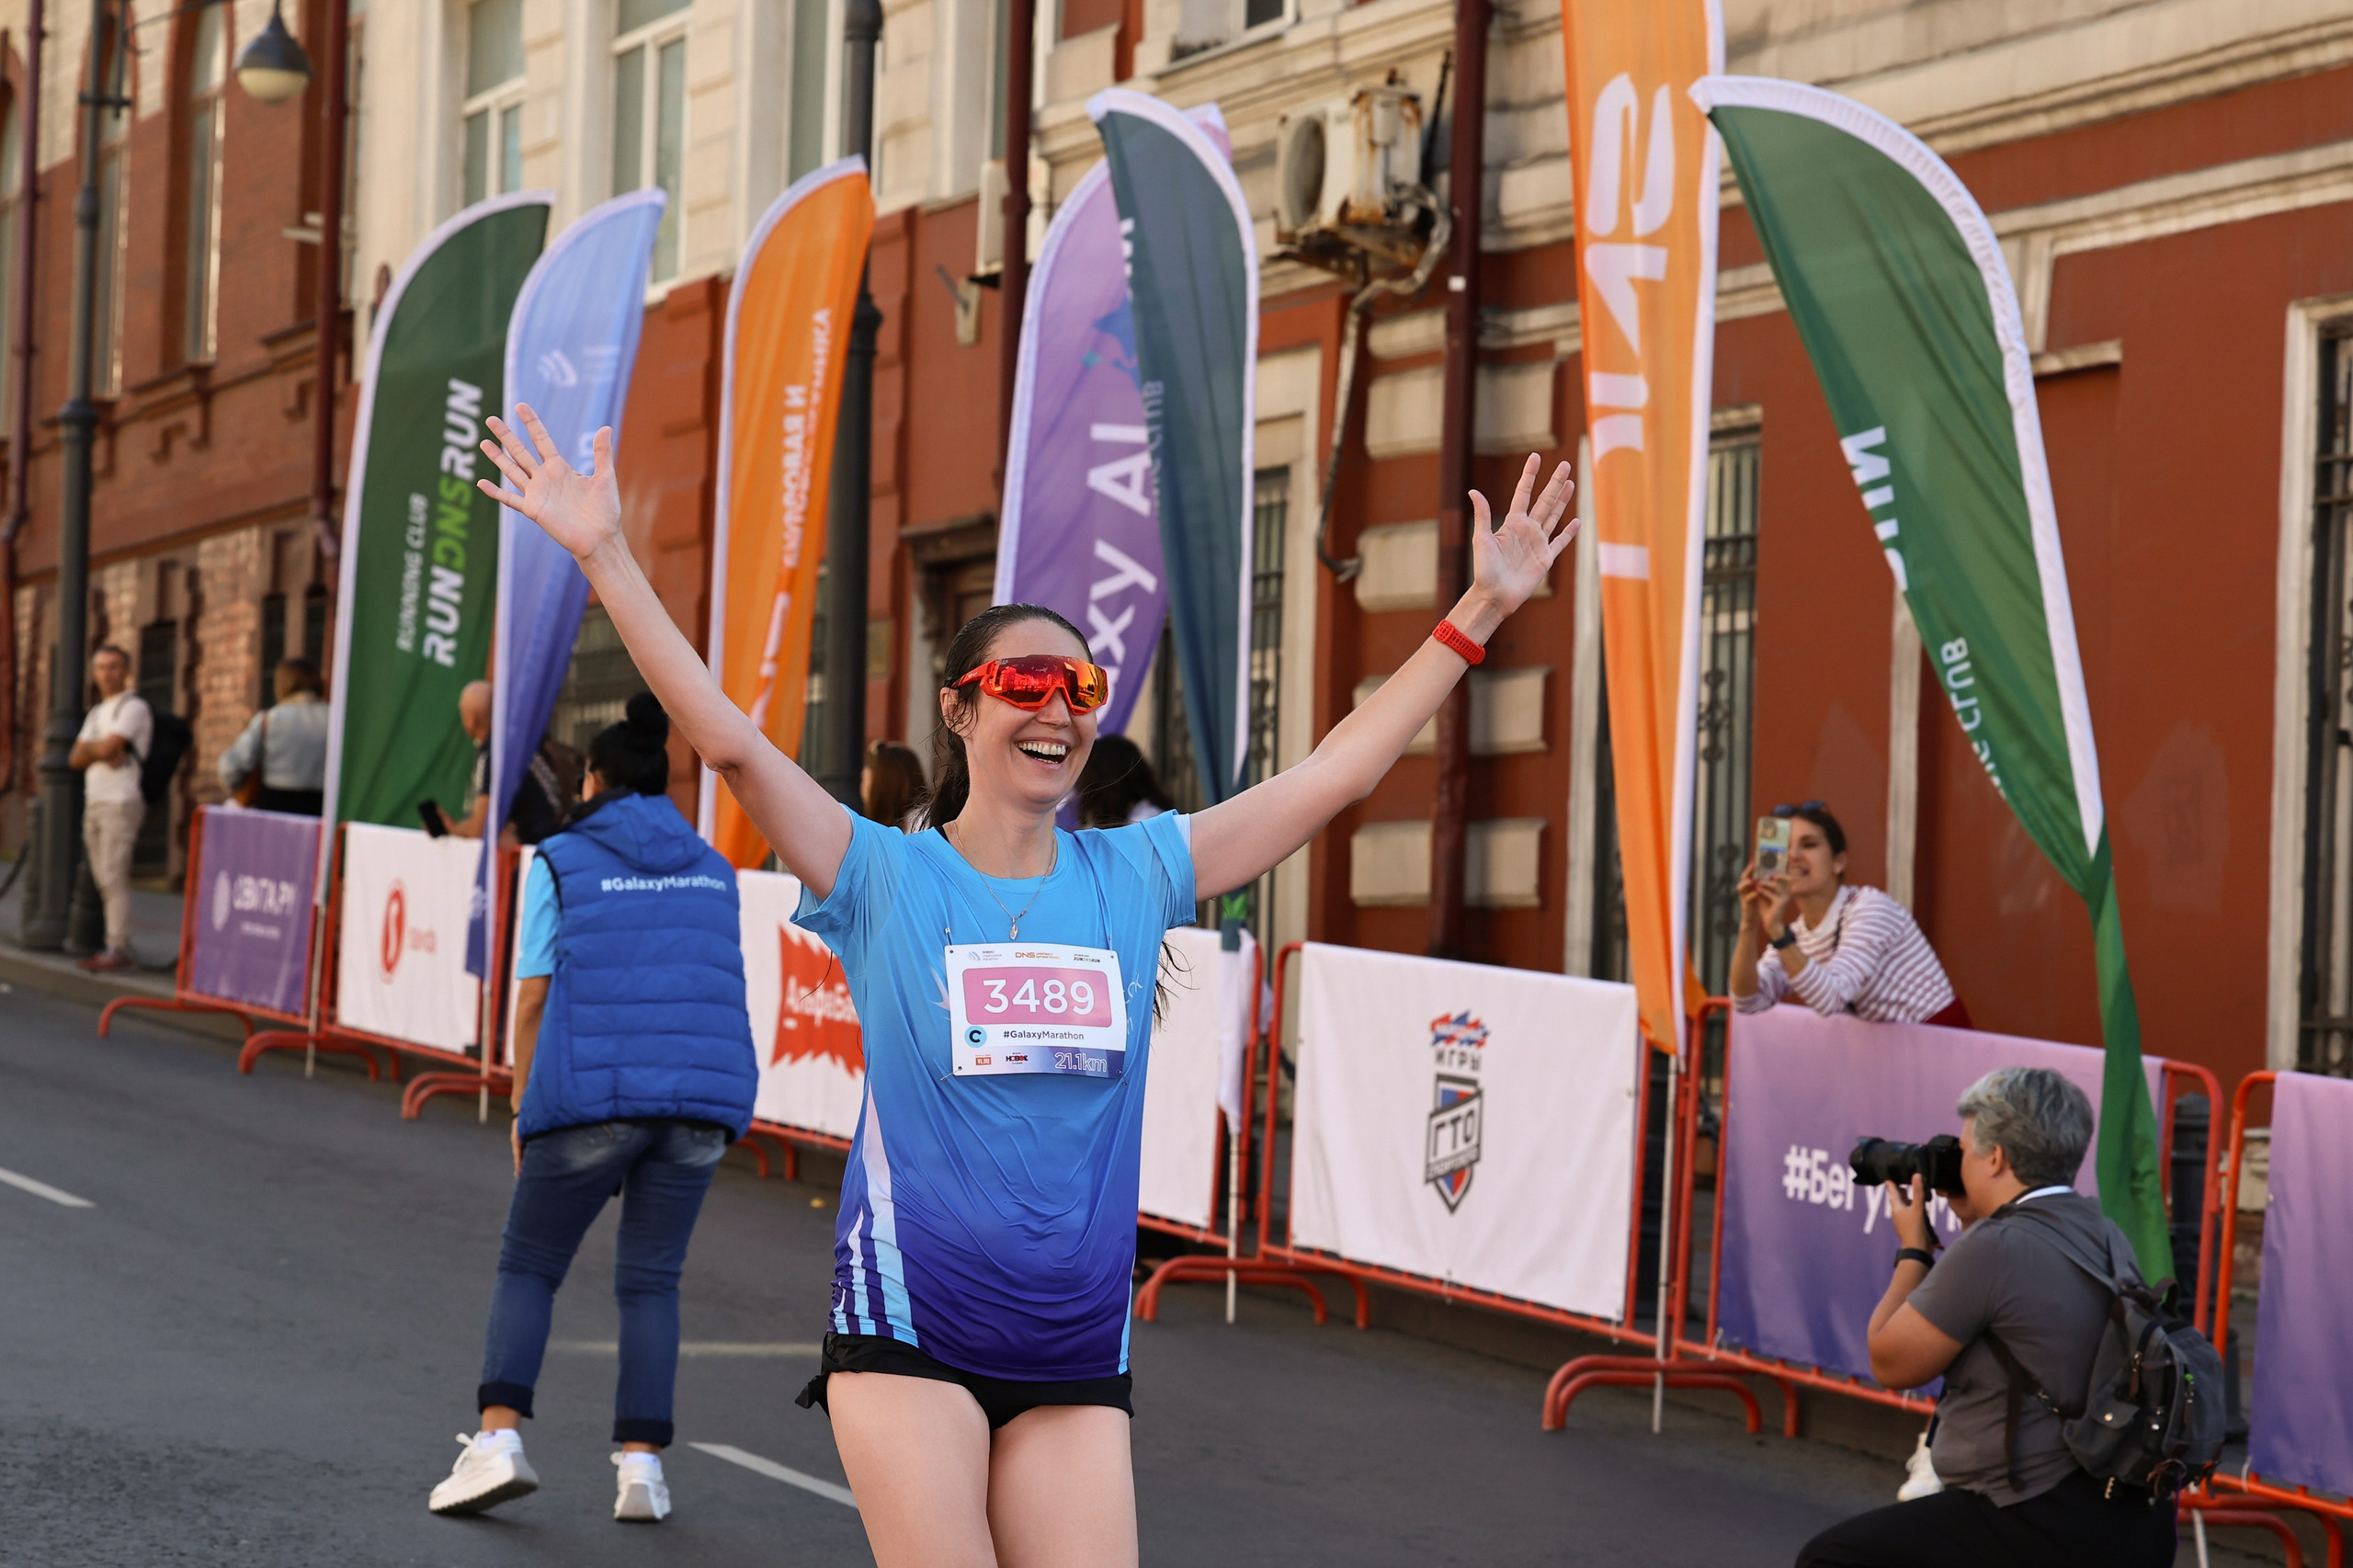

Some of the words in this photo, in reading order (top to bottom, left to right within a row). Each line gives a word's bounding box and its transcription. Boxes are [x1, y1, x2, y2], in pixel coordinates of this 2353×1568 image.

[1086, 422, 1153, 518] AI
[405, 492, 429, 550] CLUB
[601, 874, 727, 893] #GalaxyMarathon
[982, 978, 1096, 1016] 3489
[1003, 1029, 1085, 1041] #GalaxyMarathon
[1054, 1051, 1108, 1074] 21.1km
[1435, 1048, 1482, 1072] ИГРЫ
[1432, 1108, 1475, 1158] ГТО
